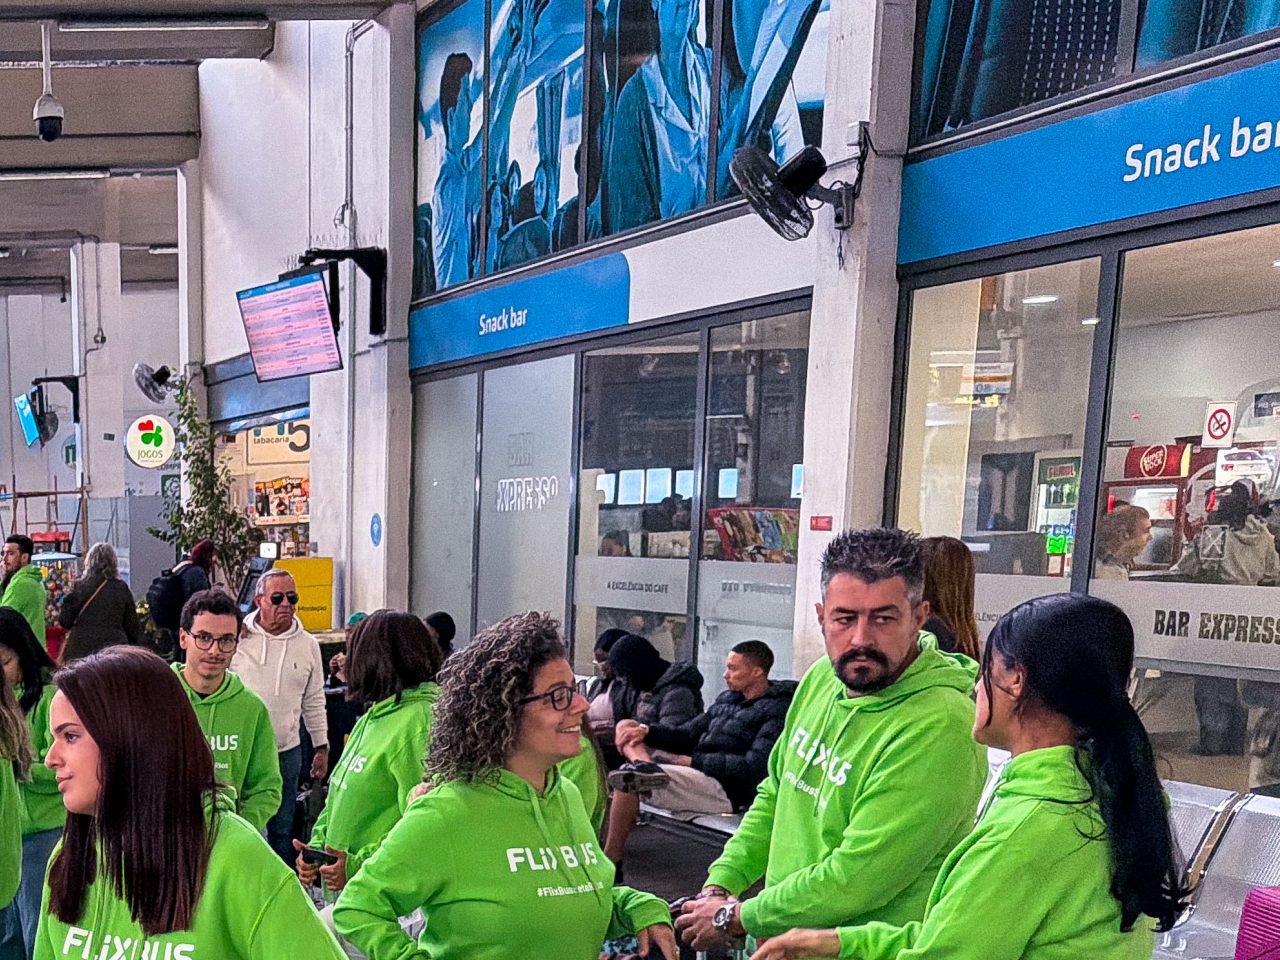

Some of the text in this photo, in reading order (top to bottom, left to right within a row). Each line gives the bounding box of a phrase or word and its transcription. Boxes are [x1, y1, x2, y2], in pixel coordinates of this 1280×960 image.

[1123, 124, 1221, 182] Snack
[478, 306, 528, 336] Snack bar
[253, 422, 311, 453] tabacaria 5
[137, 449, 164, 461] JOGOS
[1143, 449, 1164, 464] SUPER
[1153, 609, 1191, 638] BAR
